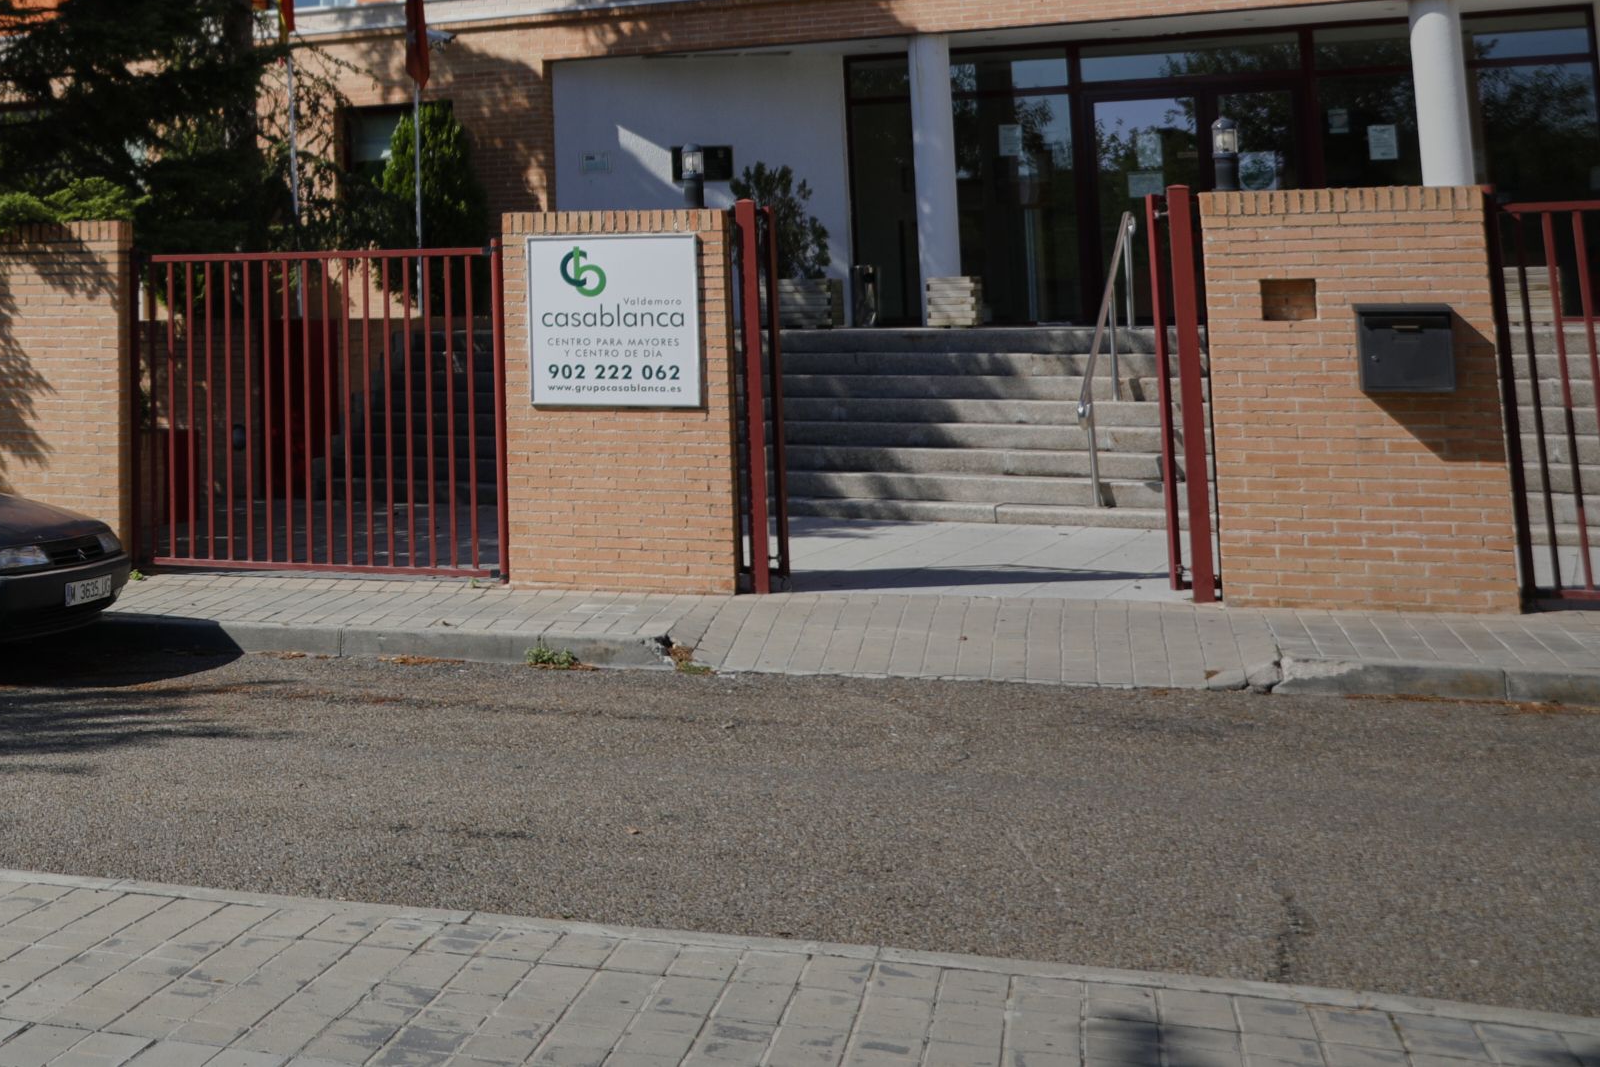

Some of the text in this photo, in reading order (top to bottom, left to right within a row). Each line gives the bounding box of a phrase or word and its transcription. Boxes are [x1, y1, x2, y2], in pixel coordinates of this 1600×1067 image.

[624, 297, 682, 306] Valdemoro
[541, 303, 685, 327] casablanca
[547, 337, 680, 347] CENTRO PARA MAYORES
[564, 347, 663, 358] Y CENTRO DE DÍA
[548, 364, 680, 380] 902 222 062
[547, 383, 682, 393] www.grupocasablanca.es
[80, 580, 99, 600] 3635
